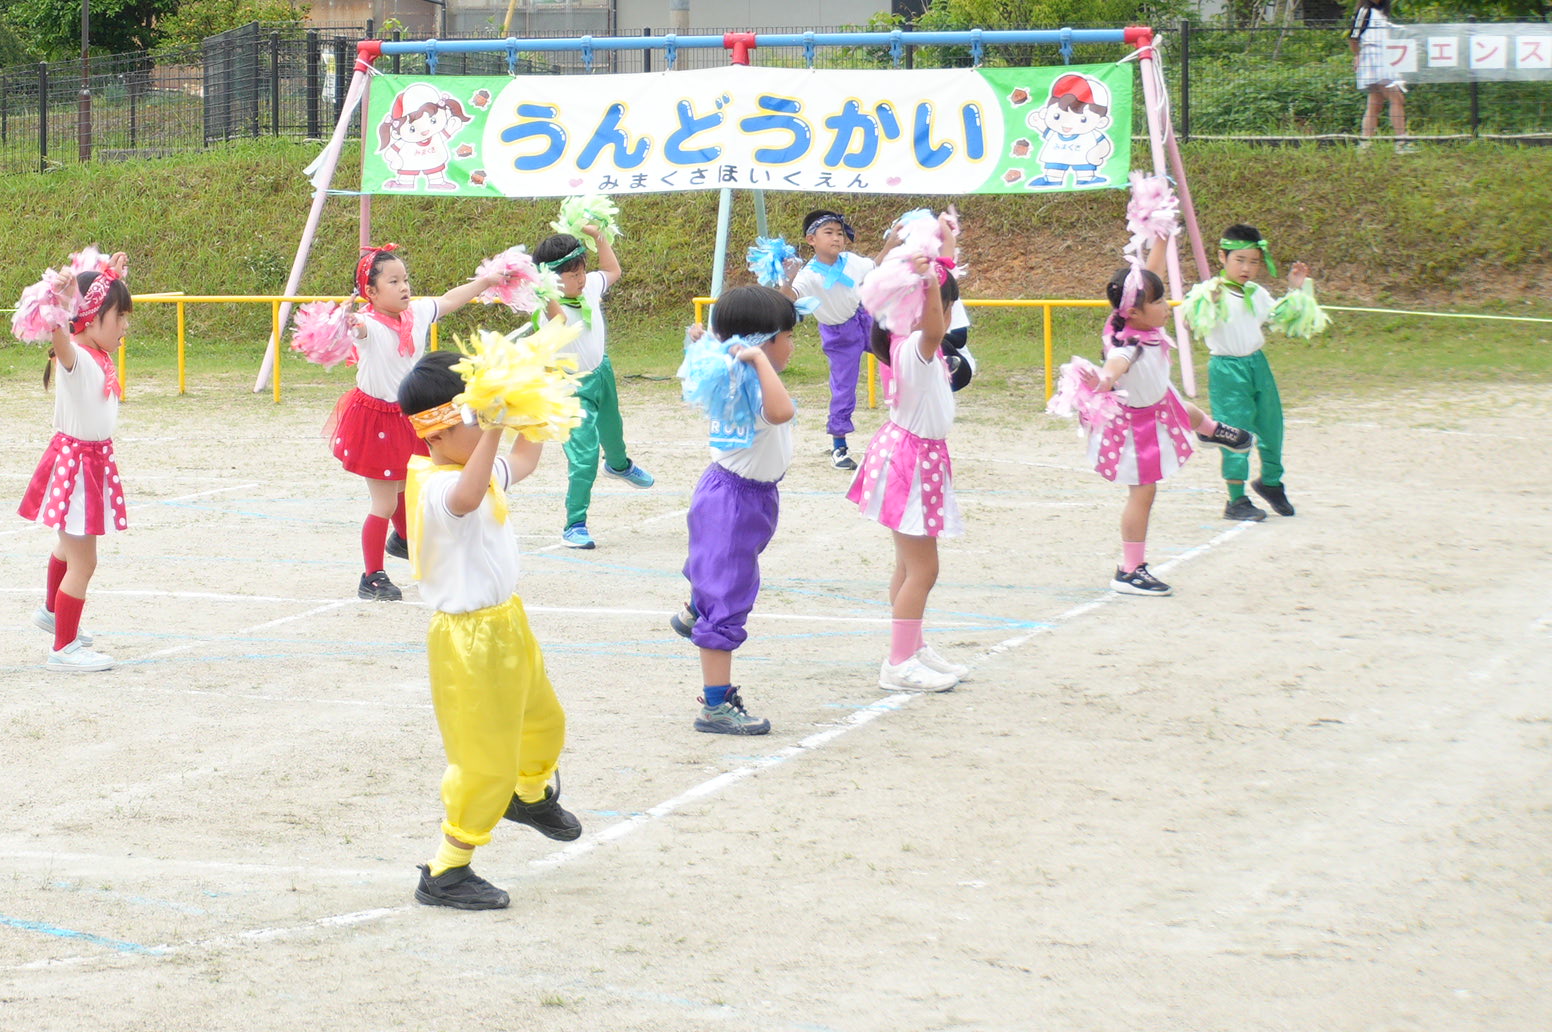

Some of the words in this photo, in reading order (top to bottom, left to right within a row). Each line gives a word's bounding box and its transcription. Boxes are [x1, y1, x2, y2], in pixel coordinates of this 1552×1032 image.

[498, 91, 986, 172] うんどうかい
[598, 164, 869, 190] みまくさほいくえん
